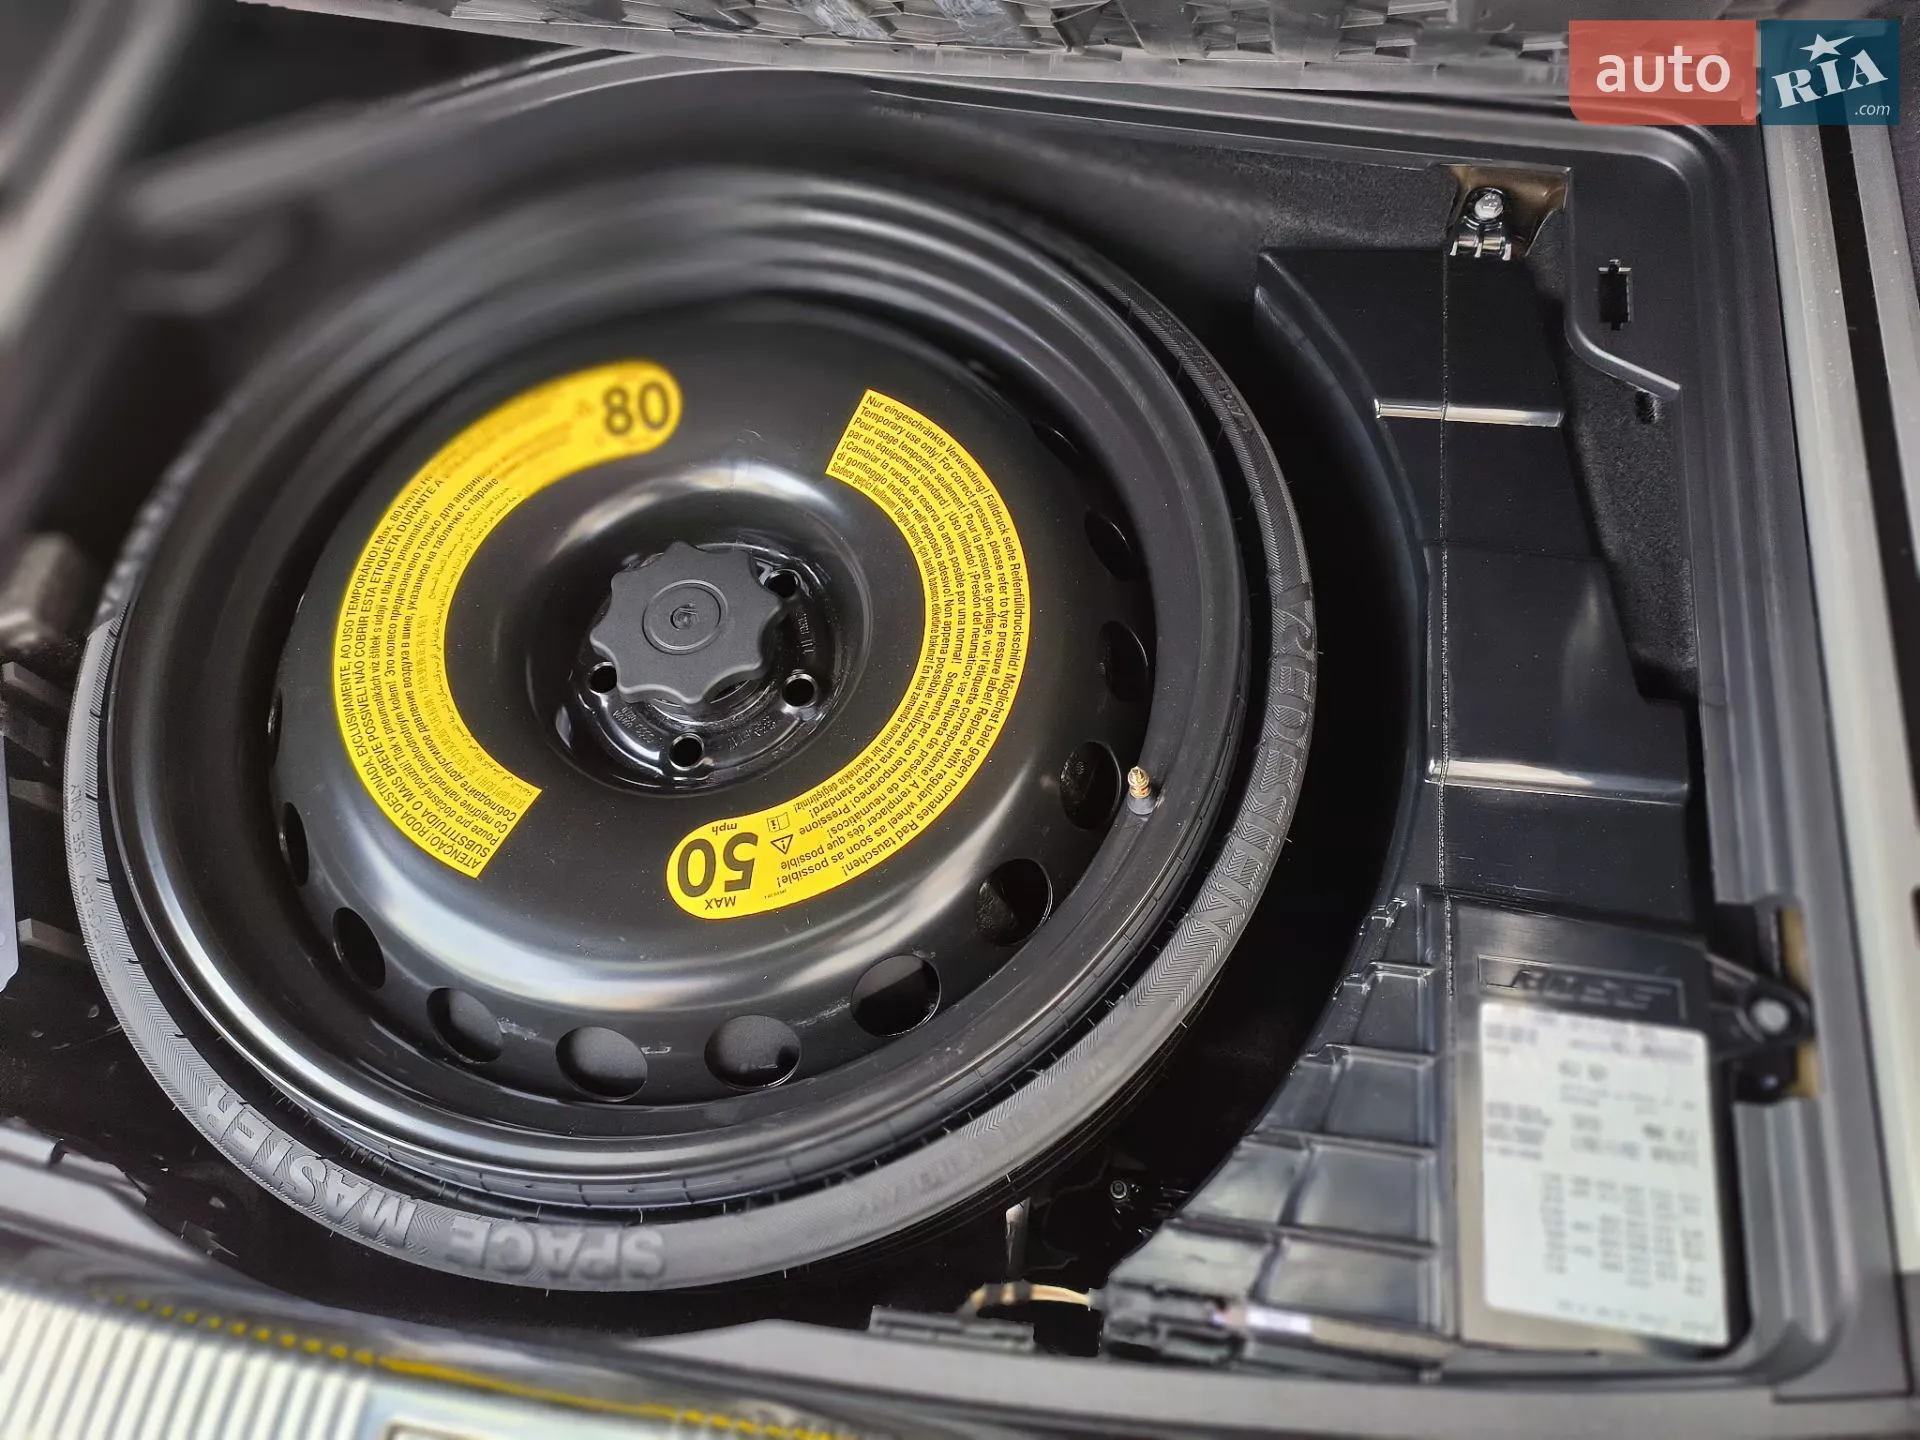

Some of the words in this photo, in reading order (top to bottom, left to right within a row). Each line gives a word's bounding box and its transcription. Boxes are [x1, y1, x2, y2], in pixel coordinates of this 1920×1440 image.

[603, 382, 670, 436] 80
[865, 394, 885, 409] Nur
[846, 429, 864, 441] par
[852, 416, 875, 432] Pour
[860, 405, 907, 435] Temporary
[883, 405, 947, 448] eingeschränkte
[873, 427, 899, 446] usage
[904, 430, 922, 445] use
[920, 441, 943, 461] only!
[844, 456, 888, 485] gonfiaggio
[887, 466, 911, 487] rueda
[937, 455, 954, 472] For
[945, 443, 991, 495] Verwendung!
[886, 480, 914, 511] indicata
[908, 484, 920, 496] de
[950, 471, 977, 501] correct
[395, 486, 437, 533] DURANTE
[439, 502, 456, 522] для
[916, 494, 941, 524] reserva
[944, 510, 962, 531] ¡Uso
[962, 512, 978, 534] Pour
[968, 498, 994, 540] pressure,
[983, 493, 1010, 536] Fülldruck
[416, 519, 442, 551] только
[432, 511, 465, 550] табличке
[940, 531, 957, 556] antes
[369, 534, 403, 584] ETIQUETA
[956, 529, 979, 569] limitado!
[973, 543, 993, 581] pression
[986, 540, 1004, 571] please
[1002, 536, 1017, 562] siehe
[345, 546, 381, 618] TEMPORÁRIO!
[389, 552, 422, 621] предназначено
[406, 563, 431, 611] указанное
[936, 559, 955, 598] adesivo!
[948, 555, 967, 589] posible
[996, 572, 1010, 595] refer
[360, 586, 378, 613] ESTA
[954, 589, 966, 606] por
[966, 570, 984, 609] ¡Presión
[983, 582, 996, 594] de
[943, 598, 955, 619] Non
[957, 607, 967, 626] una
[972, 610, 984, 626] del
[996, 609, 1011, 629] tyre
[1007, 562, 1026, 672] Reifenfülldruckschild!
[341, 619, 355, 642] USO
[354, 615, 370, 658] COBRIR
[386, 622, 398, 657] колесо
[401, 613, 416, 640] шине,
[939, 620, 952, 655] appena
[340, 644, 352, 659] AO
[950, 627, 966, 665] normal!
[981, 639, 993, 658] voir
[991, 631, 1007, 675] pressure
[352, 660, 366, 685] NÃO
[368, 660, 380, 674] viz
[383, 659, 396, 678] Это
[400, 650, 413, 689] воздуха
[921, 664, 934, 674] En
[924, 656, 947, 699] possibile
[385, 680, 402, 712] kolem!
[927, 671, 959, 721] Solamente
[980, 676, 1001, 706] label!
[987, 672, 1017, 724] Möglichst
[339, 661, 369, 758] EXCLUSIVAMENTE,
[405, 690, 431, 733] давление
[894, 700, 930, 747] riutilizzare
[934, 698, 961, 737] etiqueta
[878, 722, 902, 749] normal
[917, 720, 932, 739] per
[959, 706, 989, 747] Replace
[975, 723, 997, 749] bald
[389, 741, 406, 762] Tlak
[422, 734, 466, 782] допустимое
[870, 745, 885, 758] bir
[878, 746, 898, 764] una
[903, 738, 921, 756] uso
[926, 737, 939, 750] de
[943, 748, 964, 769] with
[370, 741, 398, 778] BREVE
[855, 763, 882, 786] ruota
[897, 748, 930, 783] presión
[954, 746, 981, 779] gegen
[1187, 583, 1316, 941] VREDESTEIN
[362, 755, 405, 814] DESTINADA,
[391, 776, 417, 803] MAIS
[427, 771, 462, 802] nahradit
[849, 756, 908, 809] temporaneo!
[886, 782, 900, 794] de
[916, 768, 948, 803] regular
[420, 787, 457, 818] dočasné
[459, 780, 517, 822] Соблюдайте
[808, 783, 857, 819] standard!
[866, 787, 912, 828] remplacer
[916, 778, 958, 822] normales
[400, 809, 430, 838] RODA
[455, 815, 475, 829] pro
[493, 820, 508, 834] Co
[711, 822, 738, 836] mph
[799, 803, 851, 835] Pressione
[826, 792, 888, 839] neumáticos!
[887, 801, 918, 830] wheel
[894, 819, 920, 842] Rad
[470, 824, 501, 847] Pouze
[826, 835, 846, 851] que
[845, 834, 874, 855] soon
[846, 824, 866, 839] dès
[873, 824, 888, 838] as
[424, 832, 482, 870] ATENÇÃO!
[678, 831, 759, 897] 50
[780, 844, 825, 871] possible
[830, 851, 845, 864] as
[841, 836, 897, 877] tauschen!
[776, 856, 830, 888] possible!
[704, 896, 737, 910] MAX
[199, 1088, 421, 1250] MASTER
[448, 1213, 668, 1284] SPACE
